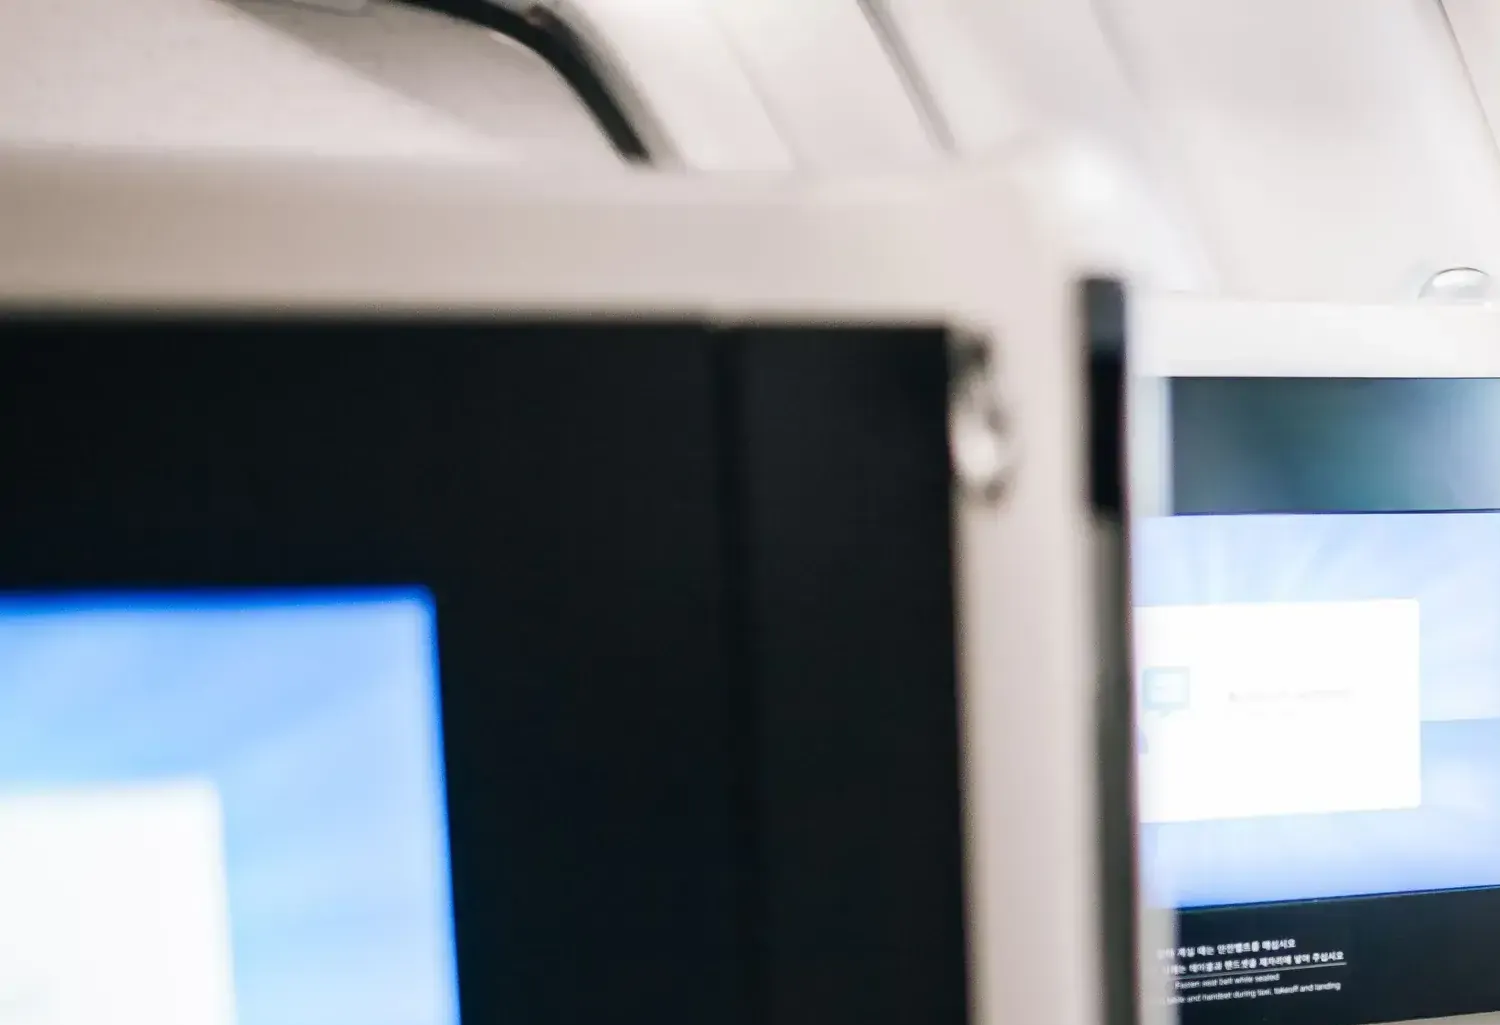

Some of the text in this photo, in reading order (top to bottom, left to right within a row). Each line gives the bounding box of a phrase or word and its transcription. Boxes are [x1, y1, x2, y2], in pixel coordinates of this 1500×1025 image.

[1219, 978, 1233, 986] belt
[1233, 990, 1256, 999] during
[1300, 984, 1313, 992] and
[1315, 982, 1341, 991] landing
